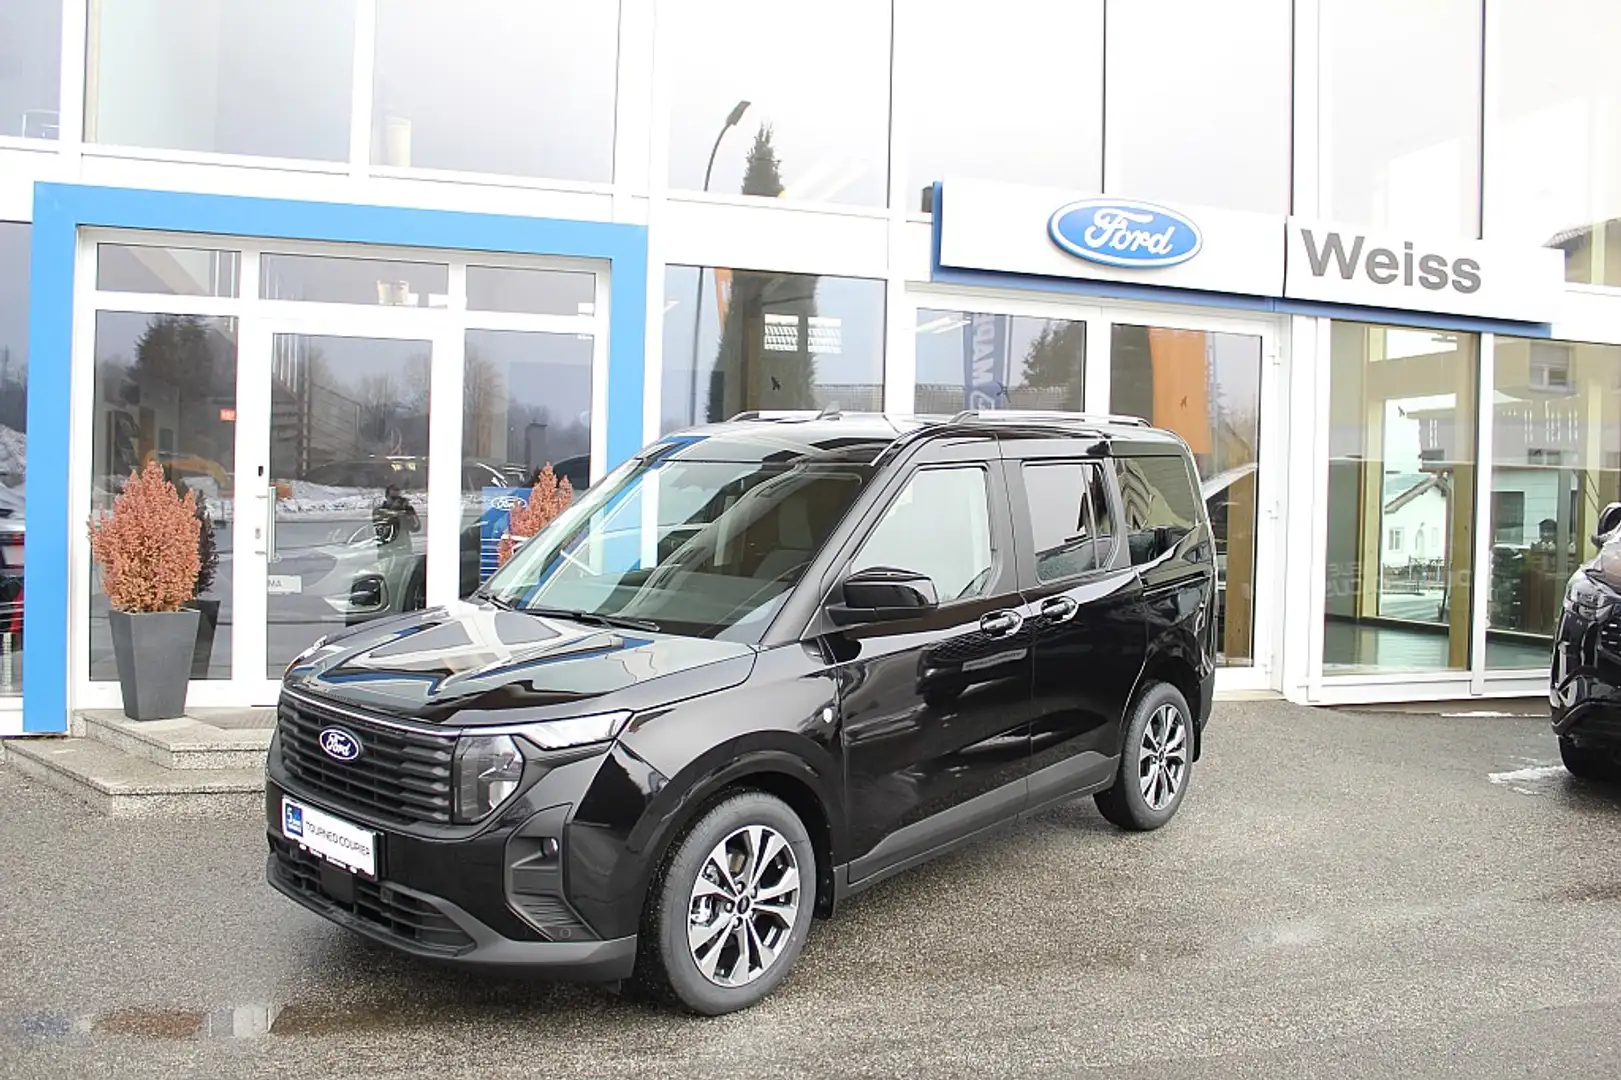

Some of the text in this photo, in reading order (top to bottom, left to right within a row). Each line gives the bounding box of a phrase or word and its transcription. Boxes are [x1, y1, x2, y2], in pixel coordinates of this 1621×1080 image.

[1084, 208, 1176, 254] Ford
[1300, 228, 1482, 294] Weiss
[326, 733, 351, 757] Ford
